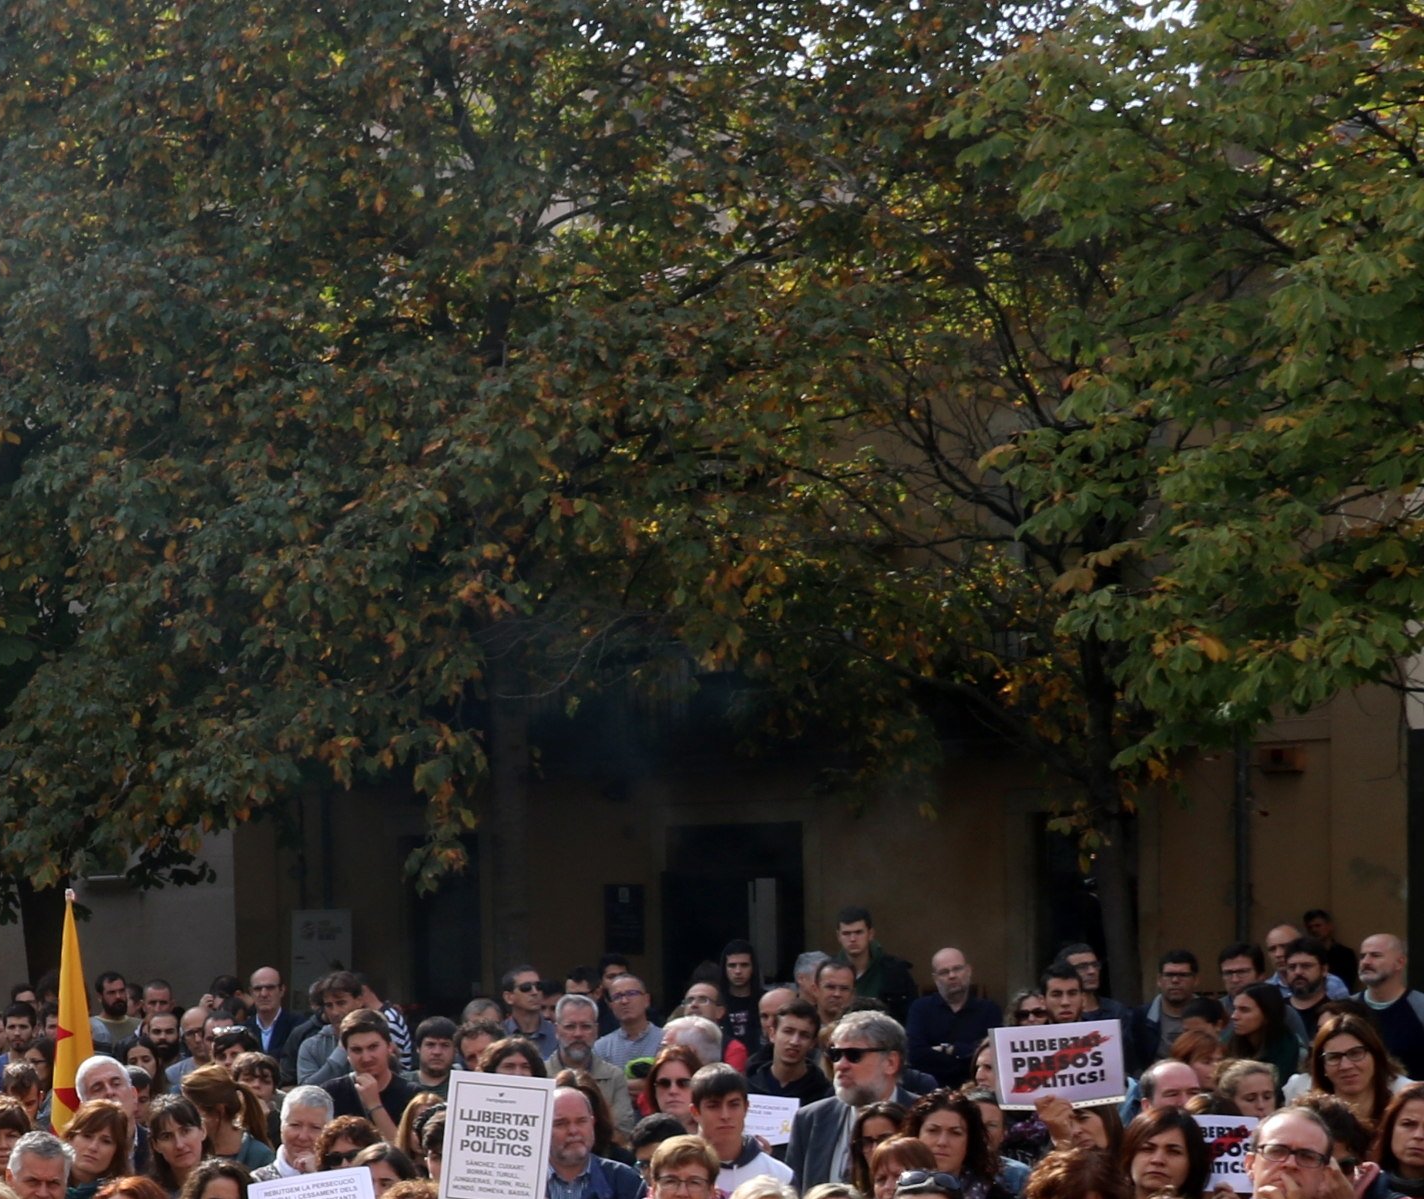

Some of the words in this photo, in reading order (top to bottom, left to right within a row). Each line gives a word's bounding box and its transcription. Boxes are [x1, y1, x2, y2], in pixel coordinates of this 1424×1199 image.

[459, 1108, 540, 1128] LLIBERTAT
[465, 1124, 530, 1142] PRESOS
[459, 1139, 533, 1157] POLÍTICS
